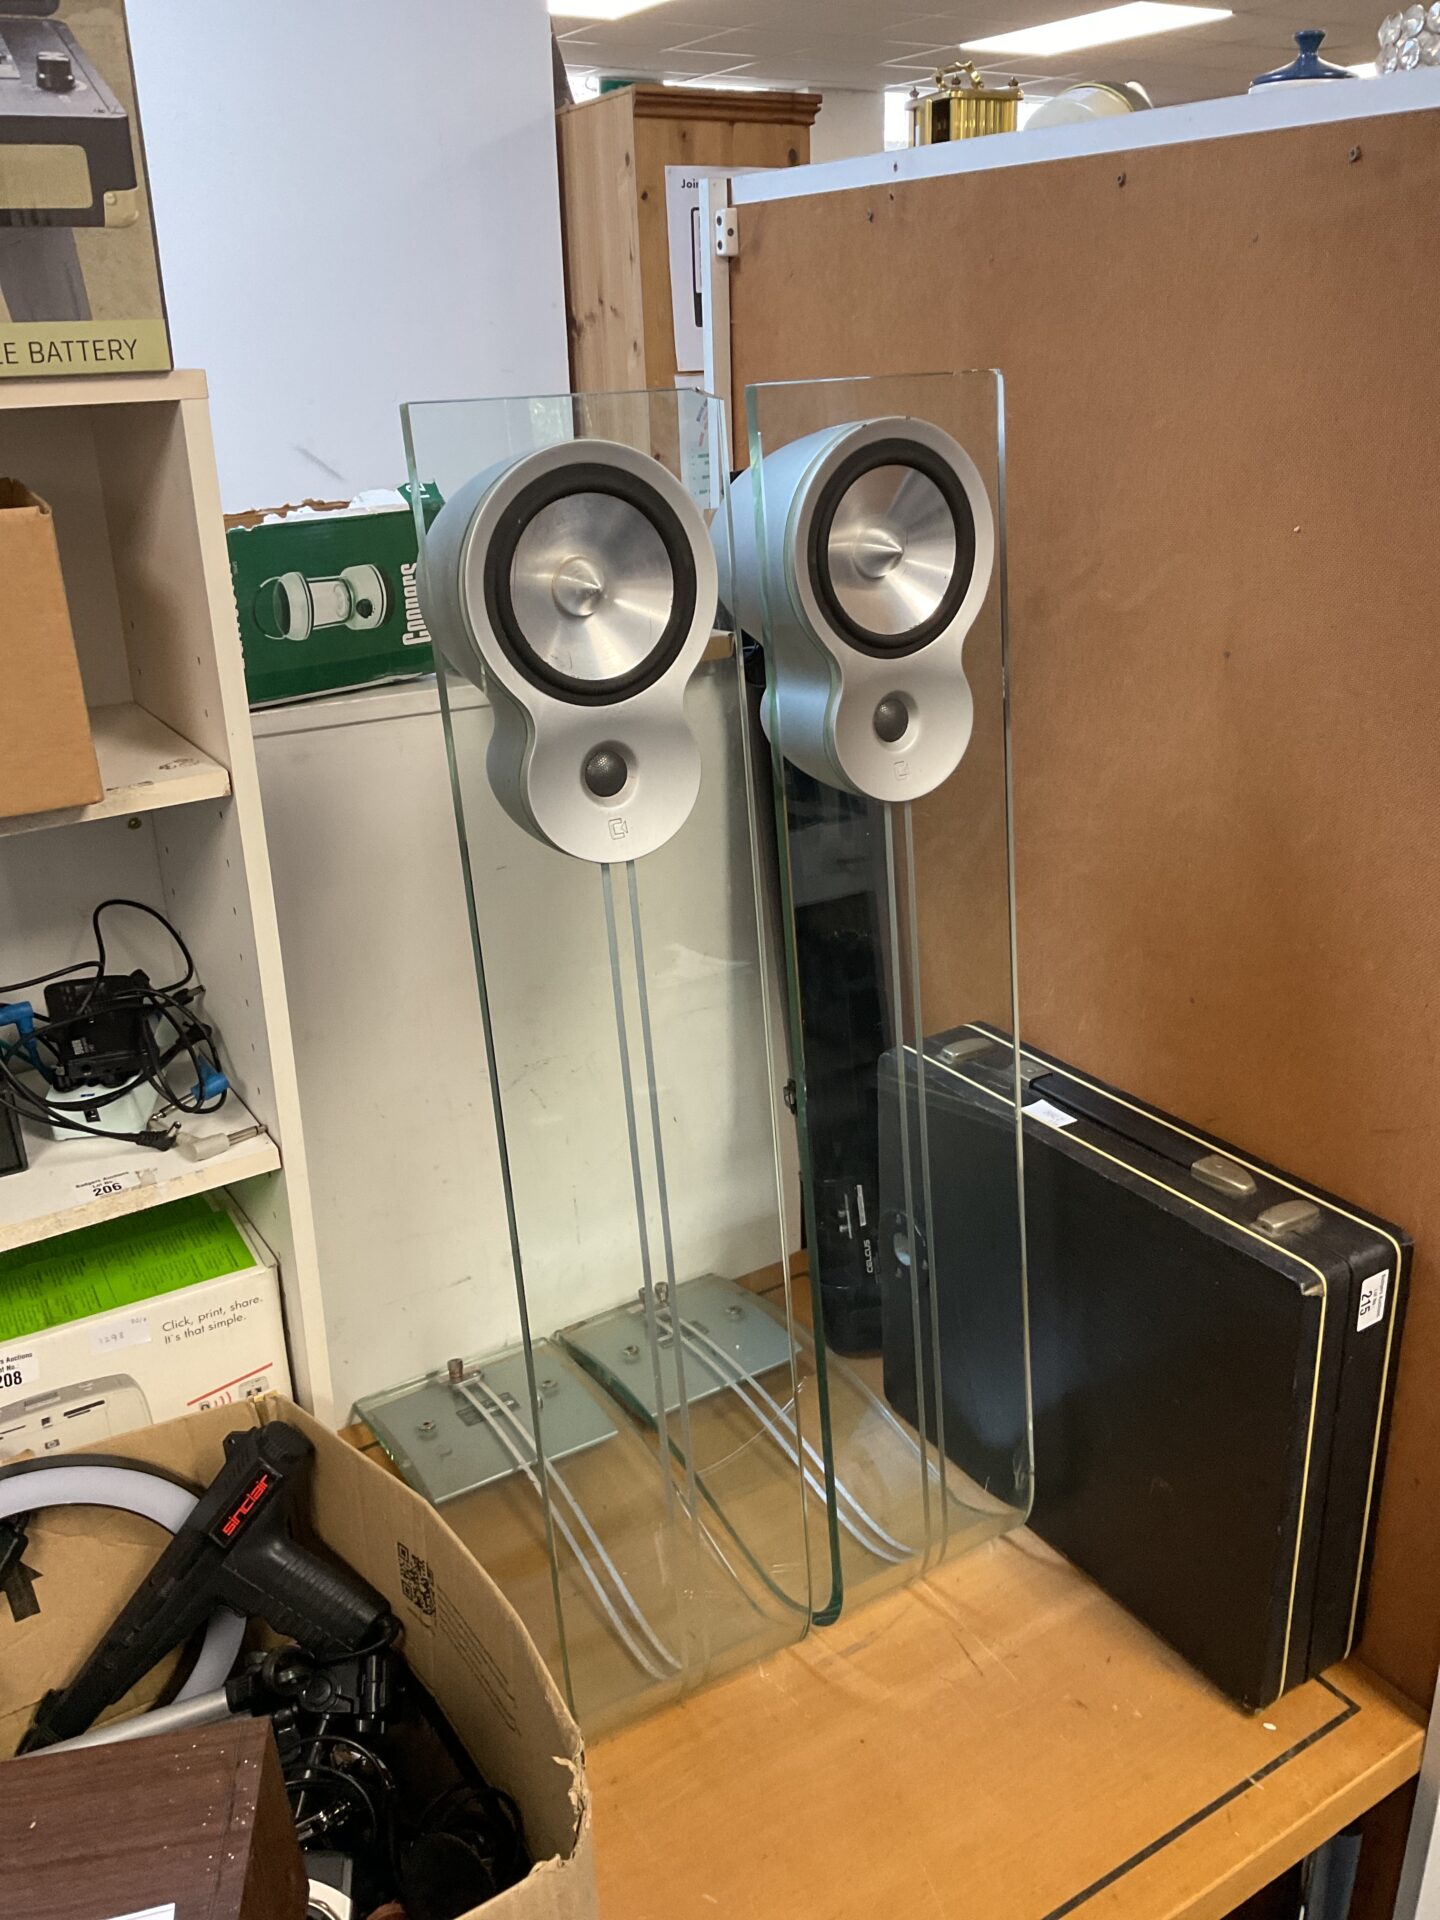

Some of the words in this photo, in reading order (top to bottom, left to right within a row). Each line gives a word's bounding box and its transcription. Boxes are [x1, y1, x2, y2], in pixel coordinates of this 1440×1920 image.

[28, 338, 137, 364] BATTERY
[92, 1182, 122, 1197] 206
[864, 1239, 873, 1273] CELCUS
[162, 1315, 194, 1332] Click,
[198, 1306, 226, 1325] print,
[230, 1296, 263, 1313] share.
[1360, 1290, 1373, 1316] 215
[184, 1324, 205, 1339] that
[208, 1313, 246, 1331] simple.
[6, 1352, 33, 1363] Auctions
[222, 1474, 268, 1537] sinclair
